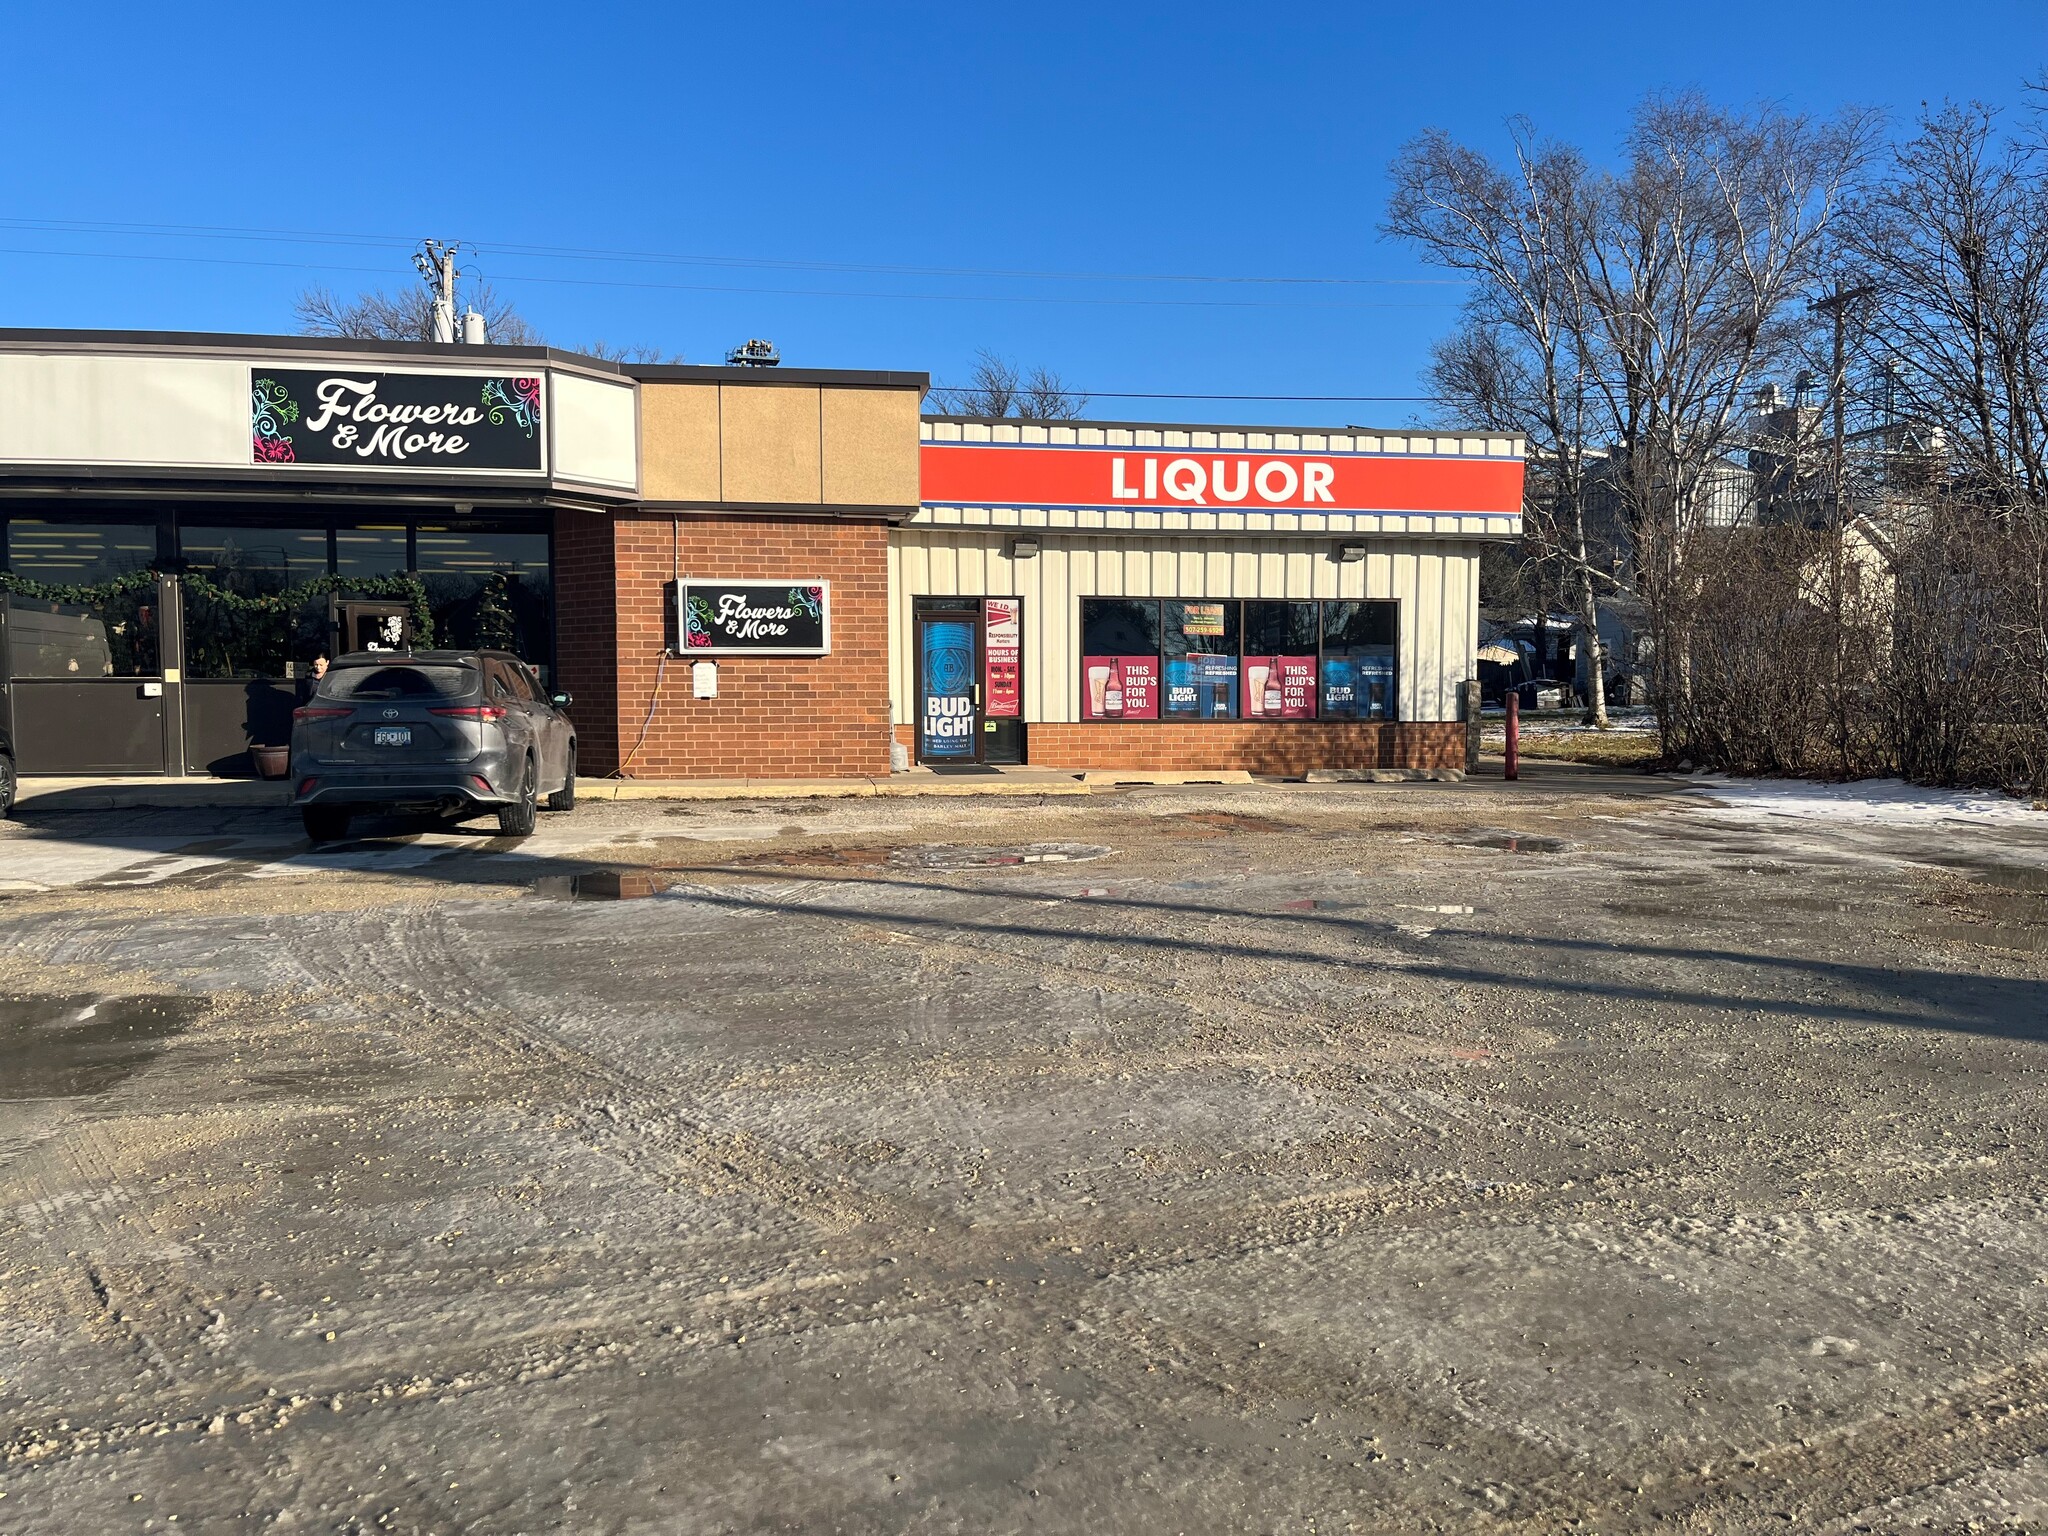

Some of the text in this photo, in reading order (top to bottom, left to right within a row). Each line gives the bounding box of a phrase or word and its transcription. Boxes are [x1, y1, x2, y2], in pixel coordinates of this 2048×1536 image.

[306, 378, 484, 431] Flowers
[332, 424, 469, 459] & More
[1112, 458, 1335, 504] LIQUOR
[714, 594, 794, 625] Flowers
[726, 619, 788, 639] & More
[1125, 666, 1149, 675] THIS
[1284, 666, 1308, 675] THIS
[1125, 676, 1157, 686] BUD'S
[1284, 676, 1315, 686] BUD'S
[1125, 687, 1146, 697] FOR
[1284, 687, 1304, 697] FOR
[1330, 686, 1351, 694] BUD
[928, 697, 970, 716] BUD
[1125, 698, 1150, 708] YOU.
[1284, 698, 1308, 707] YOU.
[924, 715, 974, 737] LIGHT
